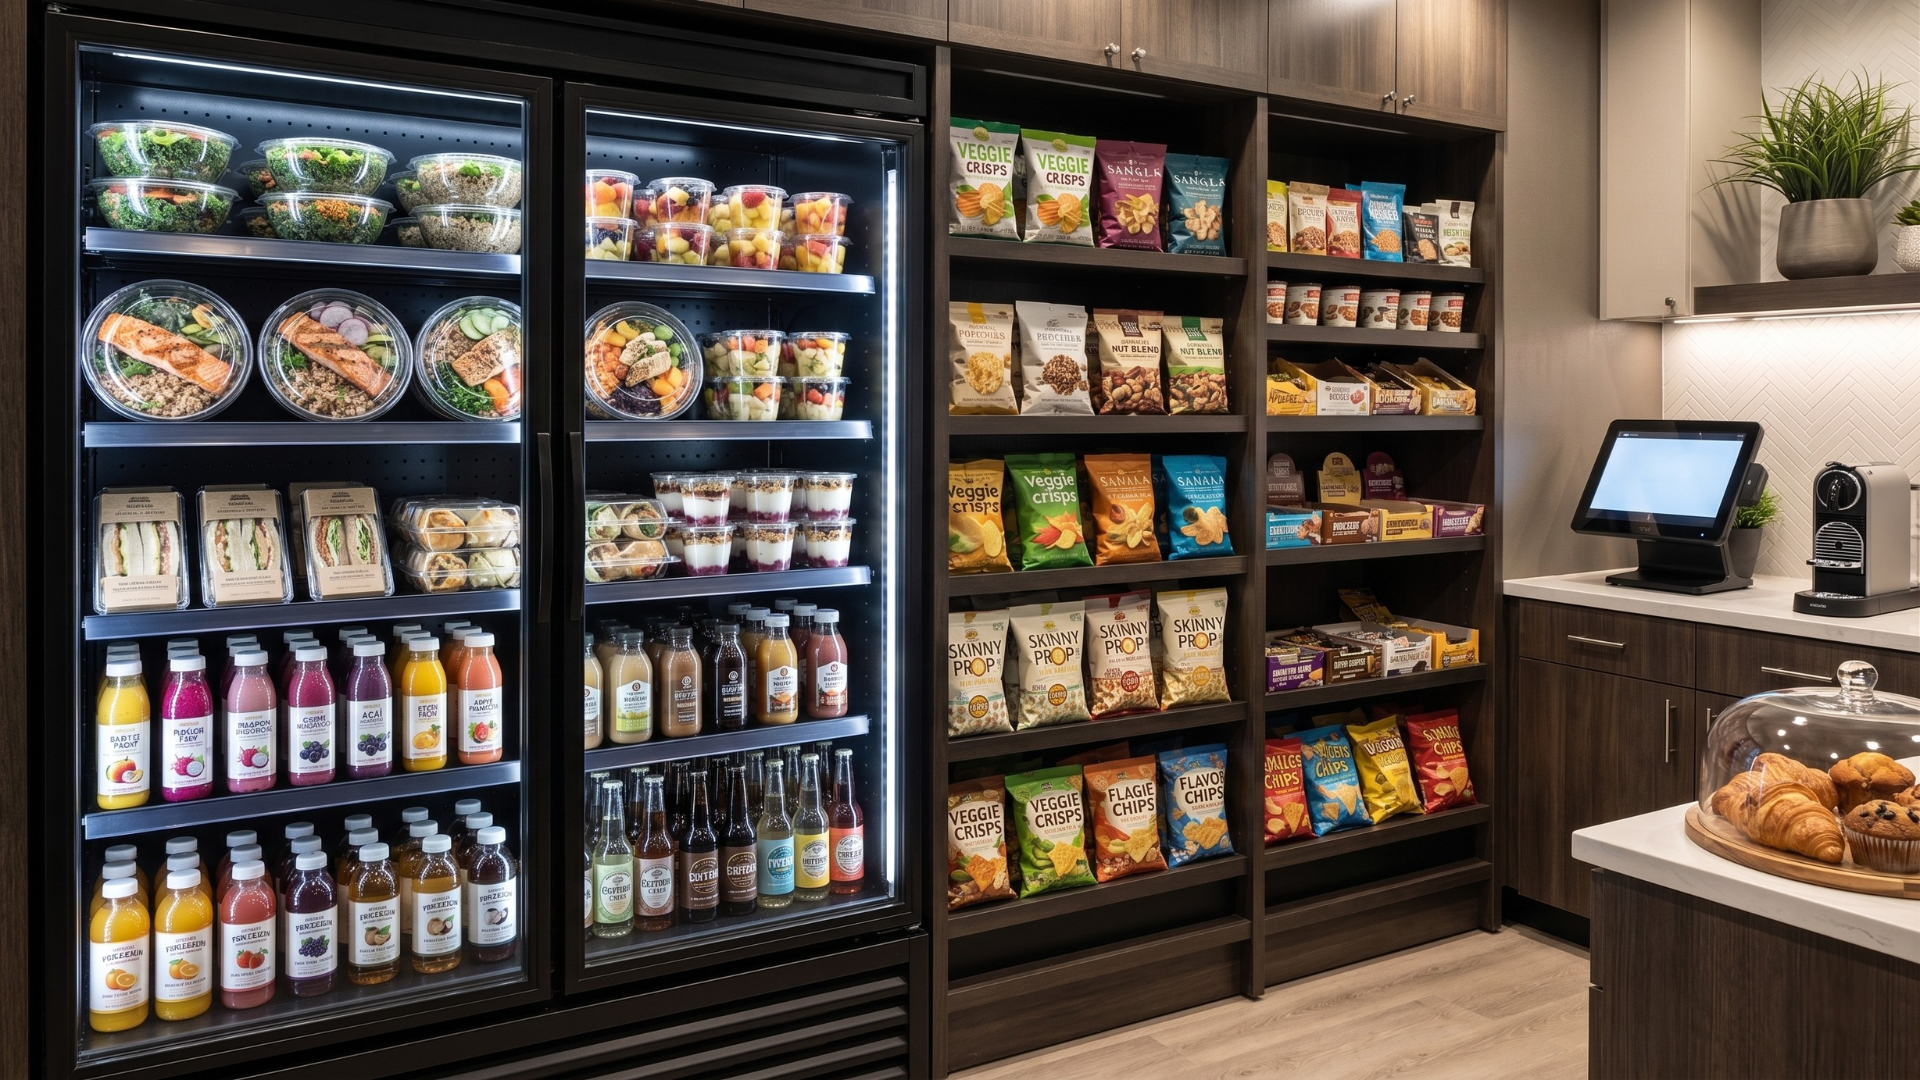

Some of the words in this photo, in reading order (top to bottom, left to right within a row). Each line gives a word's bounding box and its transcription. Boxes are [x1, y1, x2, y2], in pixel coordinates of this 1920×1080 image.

[957, 142, 1011, 164] VEGGIE
[966, 161, 1007, 176] CRISPS
[1037, 153, 1089, 174] VEGGIE
[1046, 172, 1085, 187] CRISPS
[1112, 345, 1129, 353] NUT
[1131, 346, 1159, 354] BLEND
[1023, 472, 1074, 491] Veggie
[949, 483, 999, 502] Veggie
[1032, 488, 1077, 505] crisps
[952, 501, 999, 516] crisps
[1100, 621, 1148, 639] SKINNY
[1174, 616, 1223, 633] SKINNY
[1028, 630, 1079, 649] SKINNY
[1105, 637, 1144, 655] PROP
[1178, 632, 1217, 650] PROP
[949, 640, 1002, 659] SKINNY
[1034, 646, 1075, 666] PROP
[953, 657, 995, 677] PROP
[1433, 741, 1463, 756] CHIPS
[1316, 760, 1349, 778] CHIPS
[1265, 772, 1300, 790] CHIPS
[1108, 782, 1154, 802] FLAGIE
[1184, 786, 1224, 805] CHIPS
[1030, 793, 1080, 814] VEGGIE
[1112, 798, 1155, 817] CHIPS
[949, 804, 1001, 826] VEGGIE
[1035, 808, 1082, 828] CRISPS
[954, 821, 1002, 841] CRISPS
